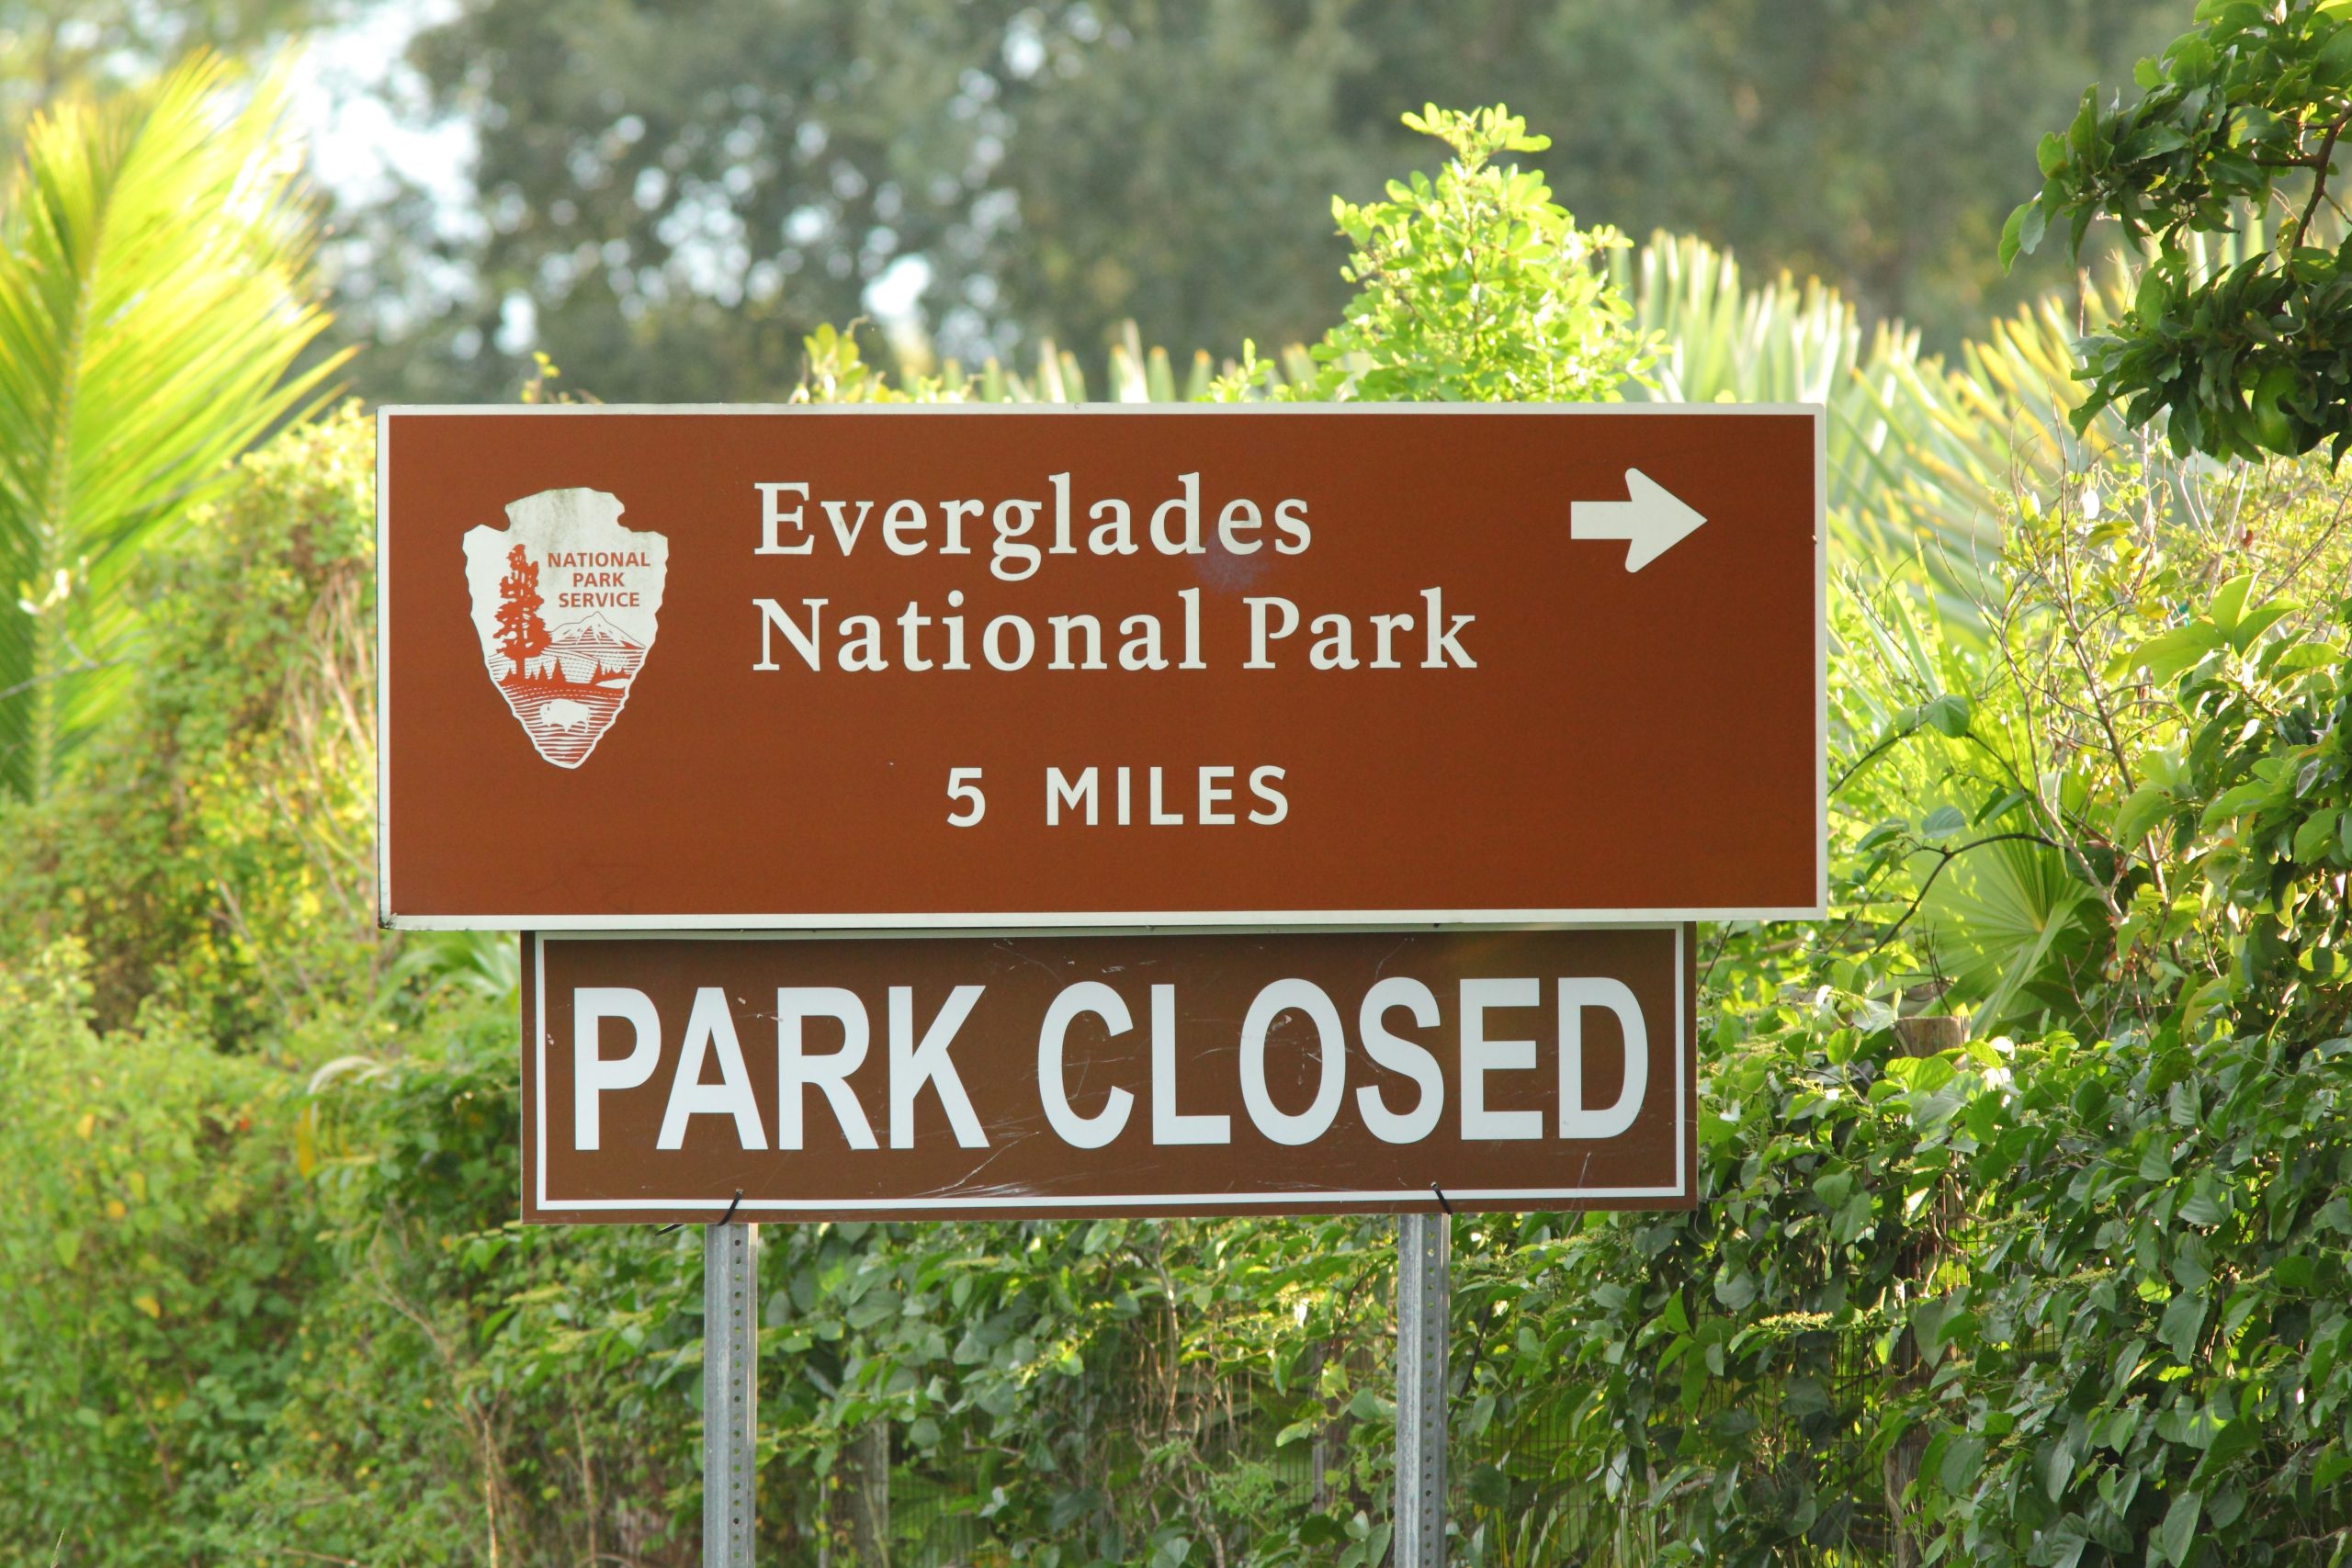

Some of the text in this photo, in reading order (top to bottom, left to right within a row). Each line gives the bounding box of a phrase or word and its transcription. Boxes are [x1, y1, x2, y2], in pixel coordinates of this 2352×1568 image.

[753, 471, 1311, 581] Everglades
[548, 551, 650, 568] NATIONAL
[572, 572, 625, 587] PARK
[559, 592, 640, 607] SERVICE
[752, 586, 1477, 672] National Park
[946, 764, 1289, 828] 5 MILES
[573, 976, 1648, 1153] PARK CLOSED
